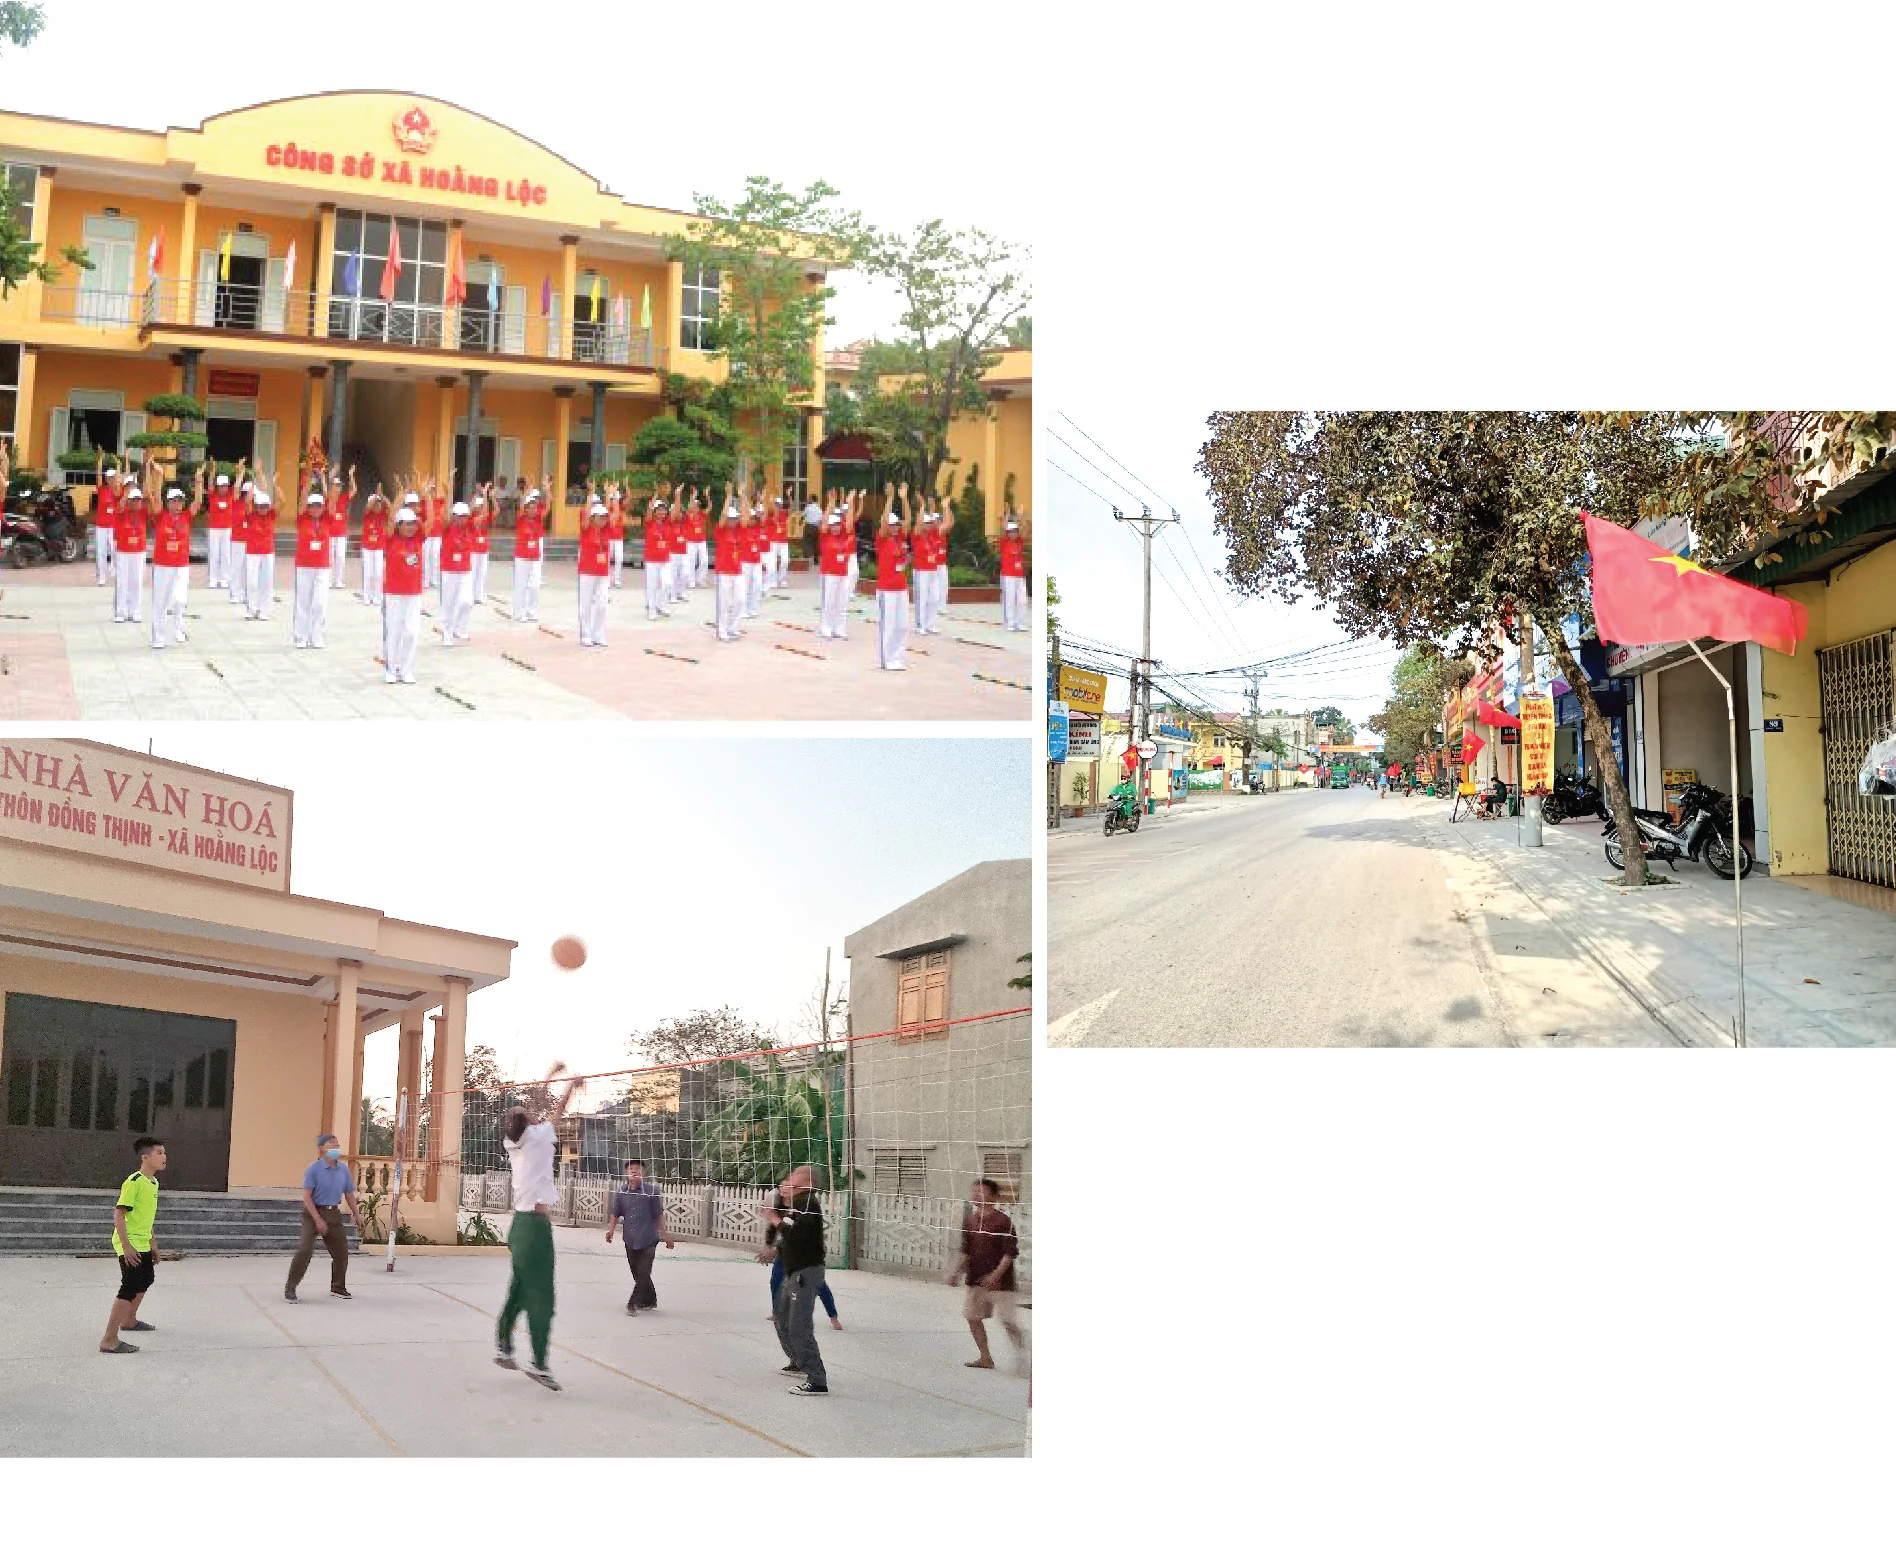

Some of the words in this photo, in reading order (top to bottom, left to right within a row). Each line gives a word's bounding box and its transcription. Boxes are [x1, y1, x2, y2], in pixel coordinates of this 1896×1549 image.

[266, 141, 334, 175] CÔNG
[342, 151, 375, 179] SỞ
[381, 160, 412, 185] XÃ
[506, 178, 547, 207] LỘC
[0, 745, 92, 797] NHÀ
[104, 769, 190, 818] VĂN
[201, 793, 277, 838] HOÁ
[48, 797, 97, 836] ĐỒNG
[103, 814, 152, 848] THỊNH
[167, 827, 190, 856] XÃ
[194, 830, 246, 868] HOẰNG
[250, 847, 278, 876] LỘC
